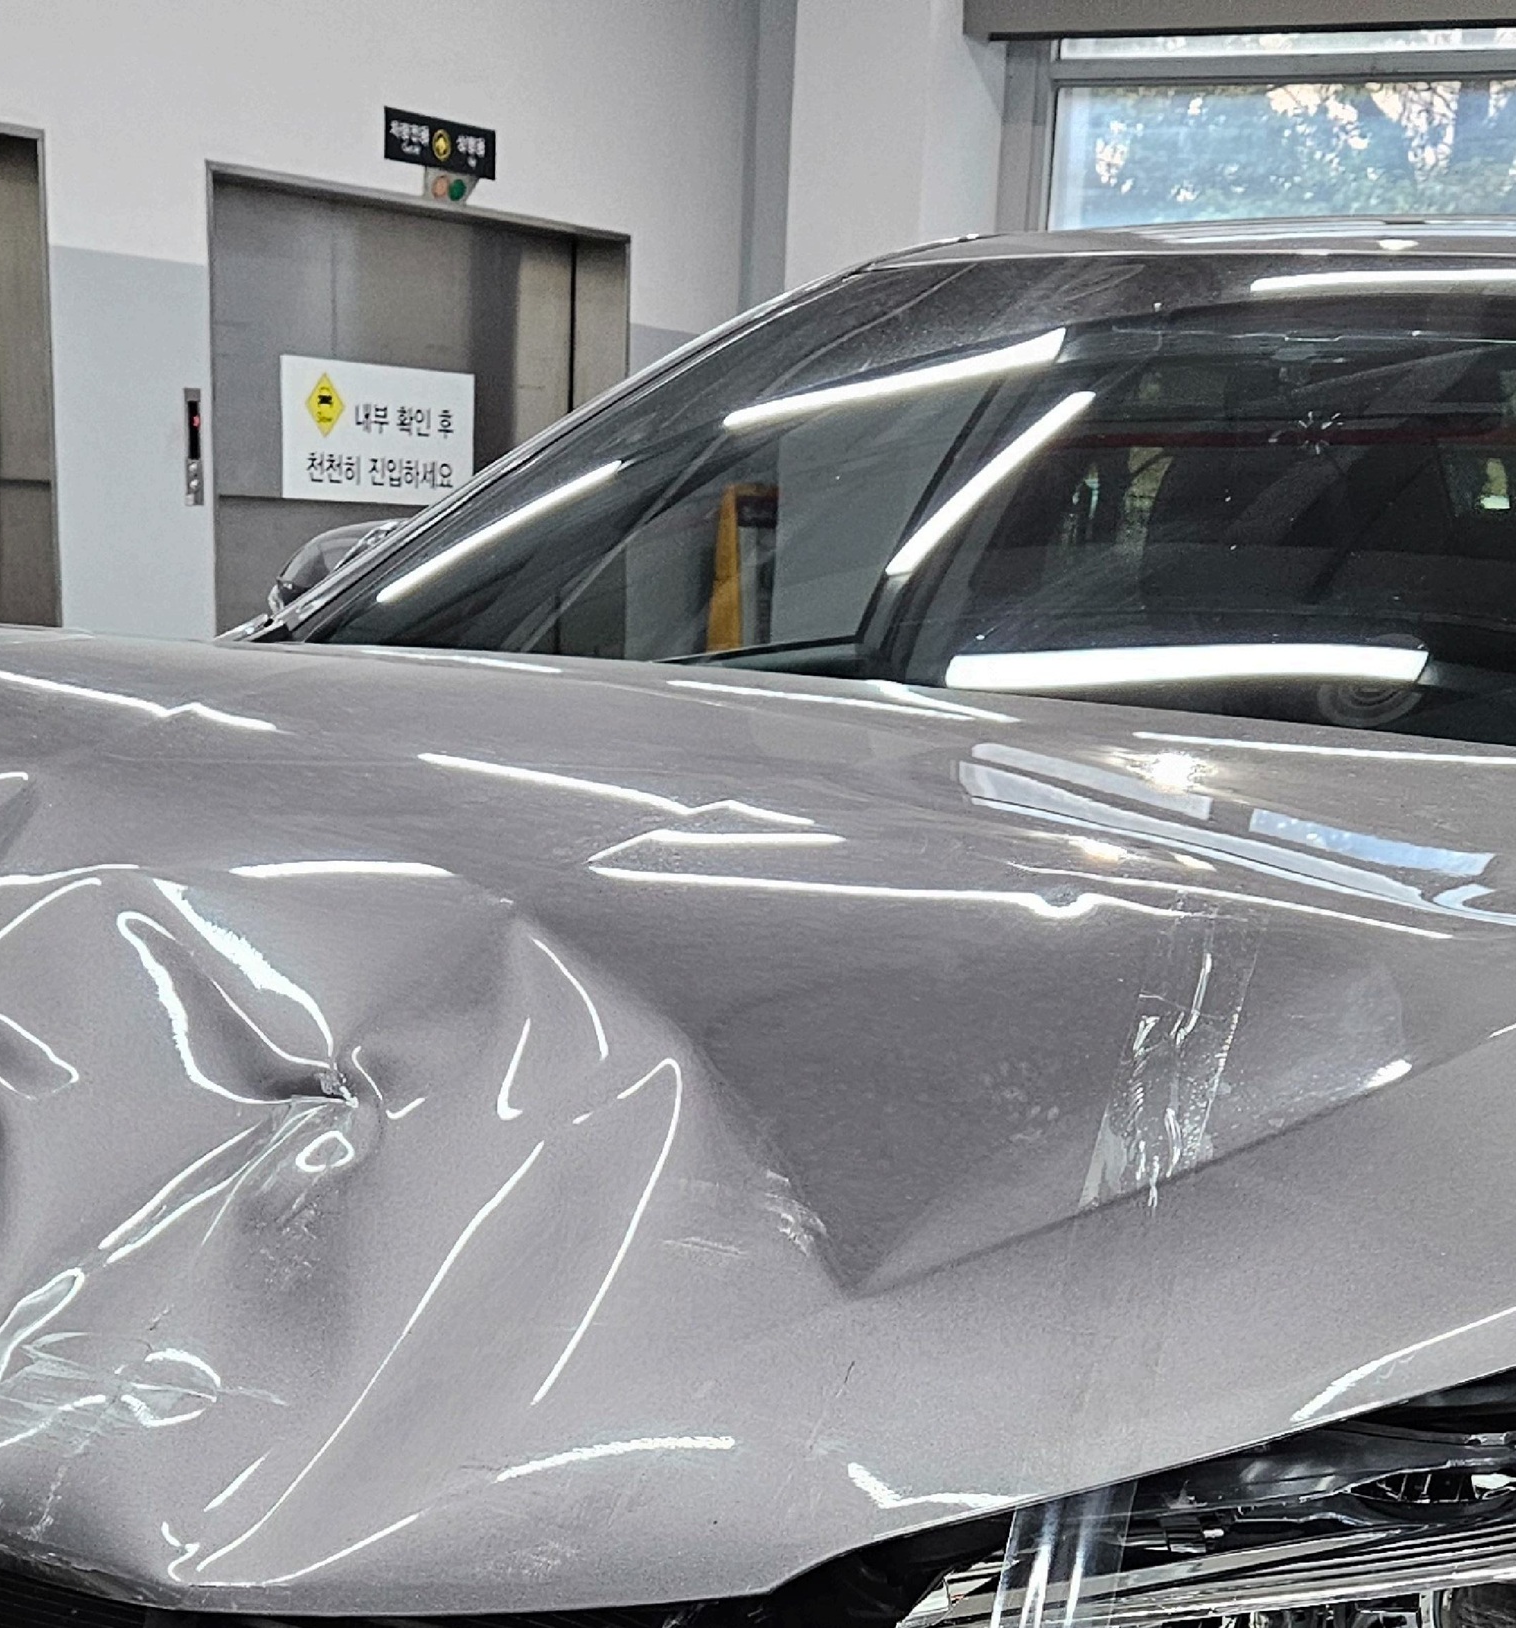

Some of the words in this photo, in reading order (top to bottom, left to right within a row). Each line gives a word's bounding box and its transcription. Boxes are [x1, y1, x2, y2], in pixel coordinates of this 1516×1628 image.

[355, 403, 389, 434] 내부
[396, 405, 431, 437] 확인
[437, 409, 454, 439] 후
[306, 450, 362, 486] 천천히
[368, 457, 454, 490] 진입하세요
